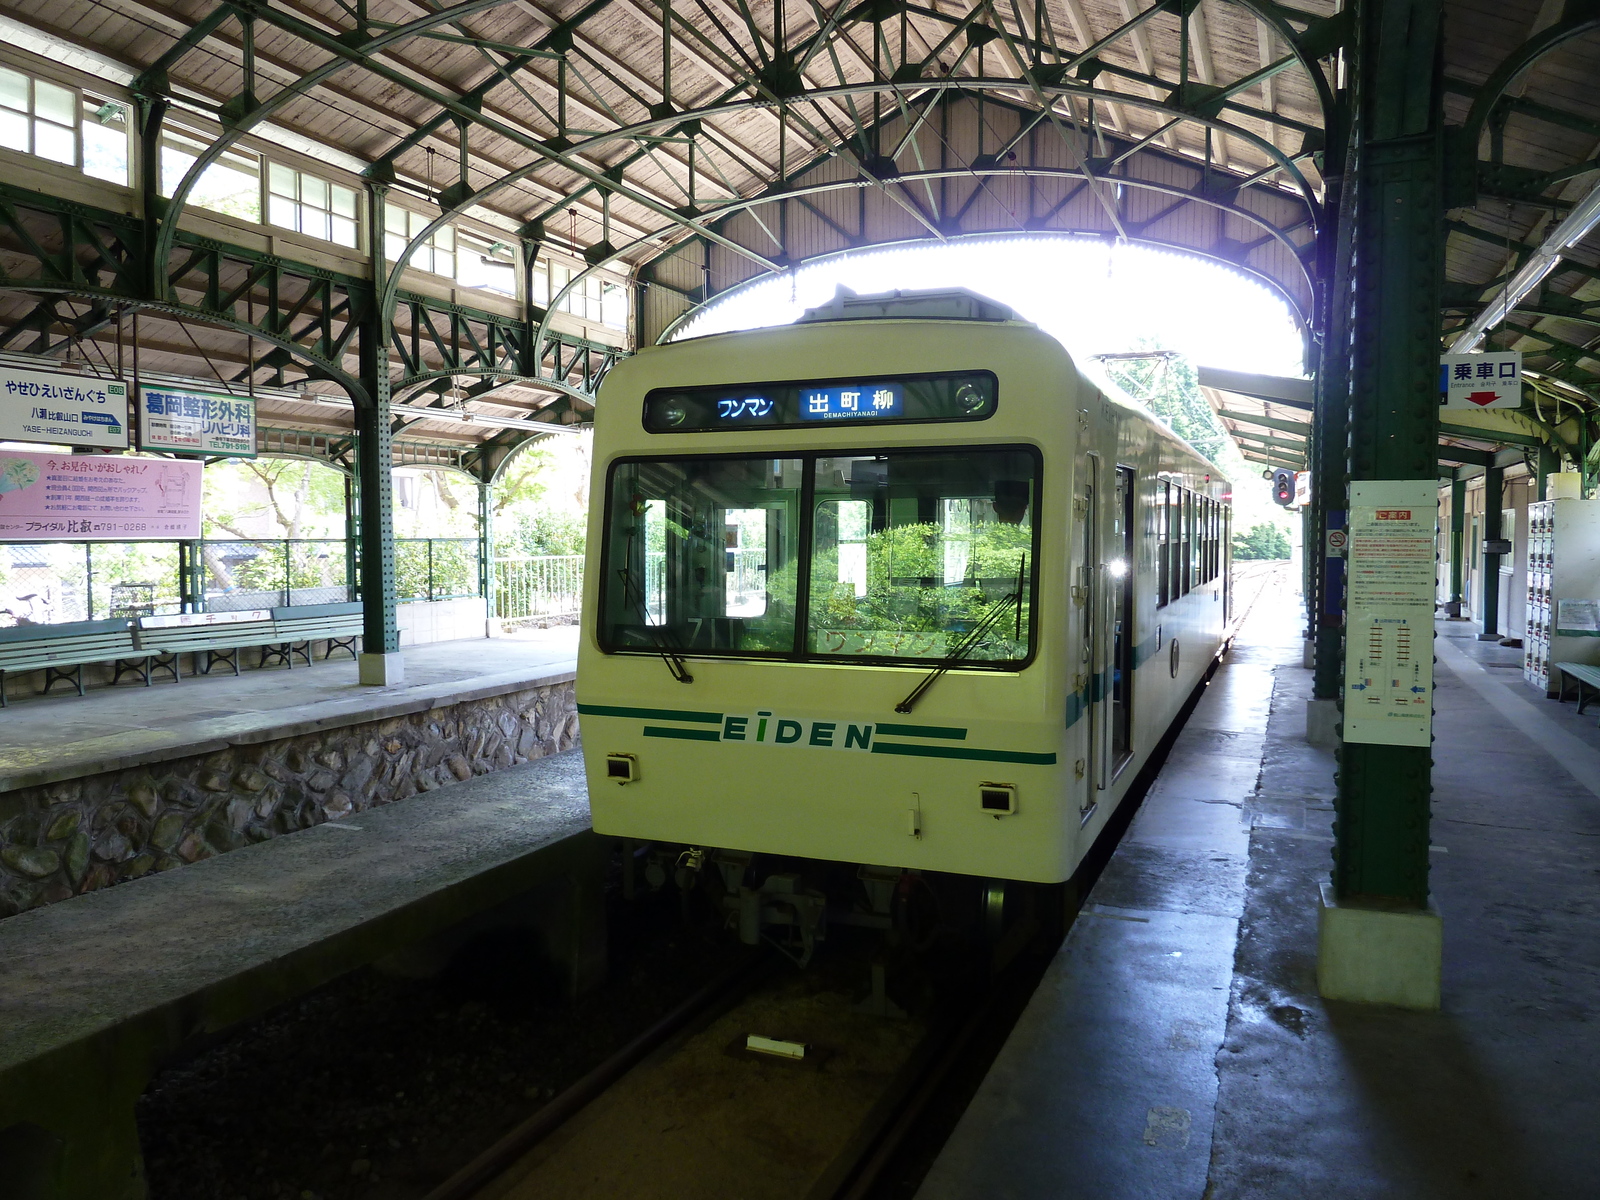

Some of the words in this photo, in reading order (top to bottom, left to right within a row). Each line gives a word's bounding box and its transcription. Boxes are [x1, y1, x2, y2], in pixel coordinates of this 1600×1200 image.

[1453, 361, 1516, 381] 乗車口
[5, 380, 106, 404] やせひえいざんぐち
[109, 385, 124, 395] E08
[145, 392, 251, 424] 葛岡整形外科
[717, 398, 774, 418] ワンマン
[808, 389, 894, 413] 出町柳
[31, 407, 79, 423] 八瀬比叡山口
[823, 410, 878, 419] DEMACHIYANAGI
[22, 424, 93, 438] YASE-HIEIZANGUCHI
[201, 420, 251, 438] リハビリ科
[67, 519, 92, 533] 比叡
[100, 522, 147, 532] 791-0268
[687, 617, 735, 649] 711
